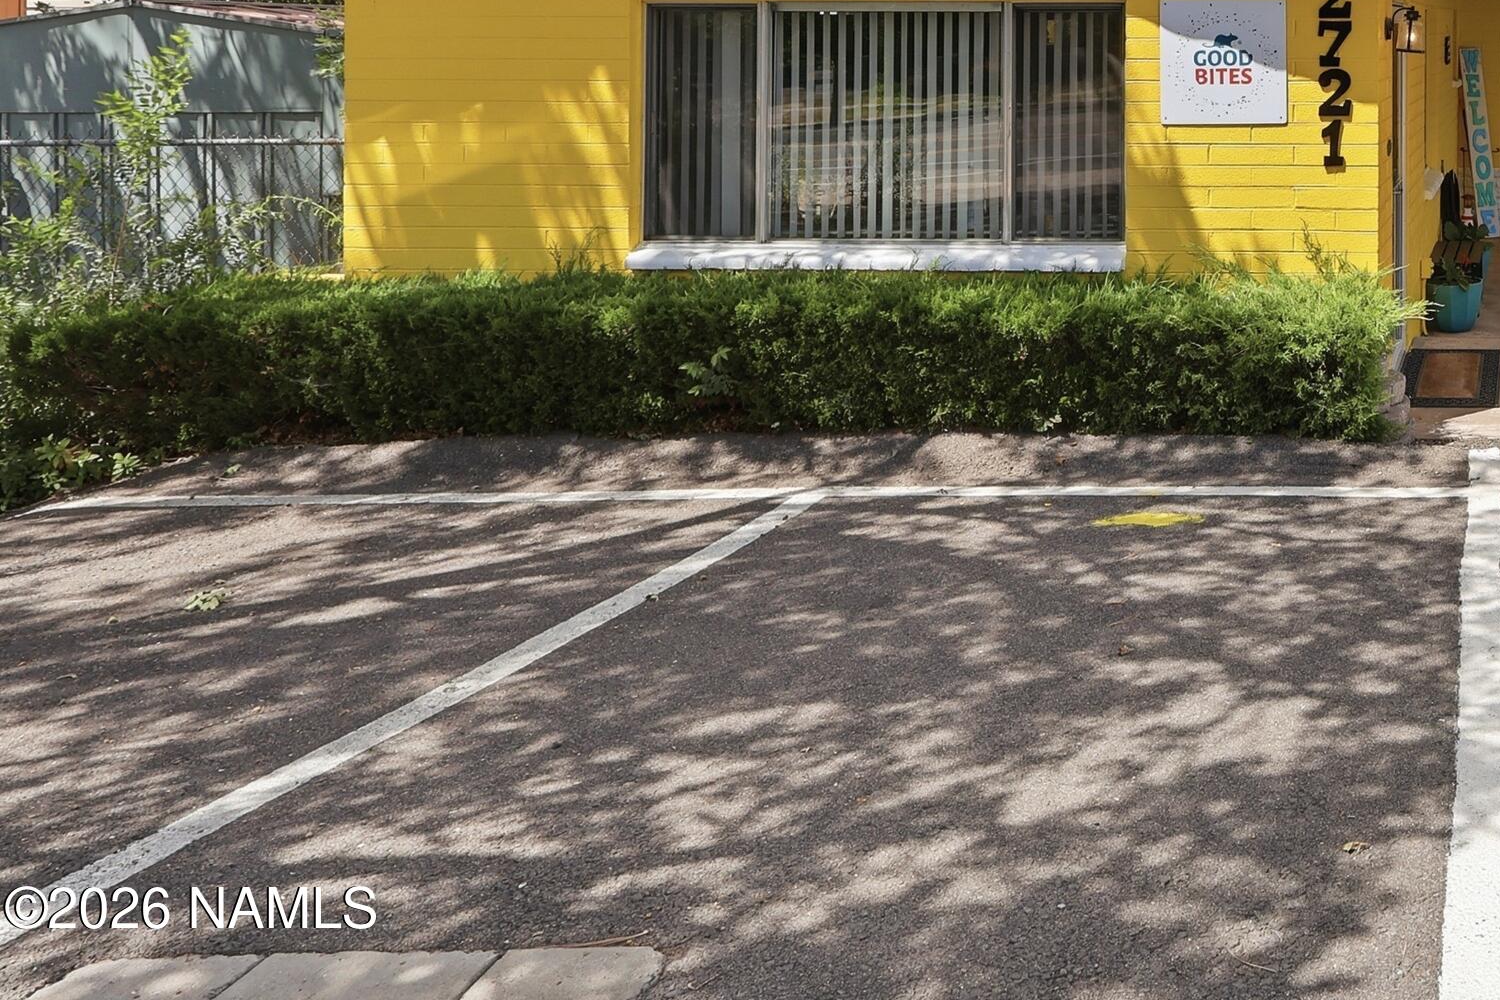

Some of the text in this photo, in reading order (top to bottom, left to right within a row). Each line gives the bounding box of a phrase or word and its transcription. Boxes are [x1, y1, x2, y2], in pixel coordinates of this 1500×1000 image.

[1193, 49, 1253, 66] GOOD
[1195, 67, 1253, 85] BITES
[1460, 50, 1497, 234] WELCOME
